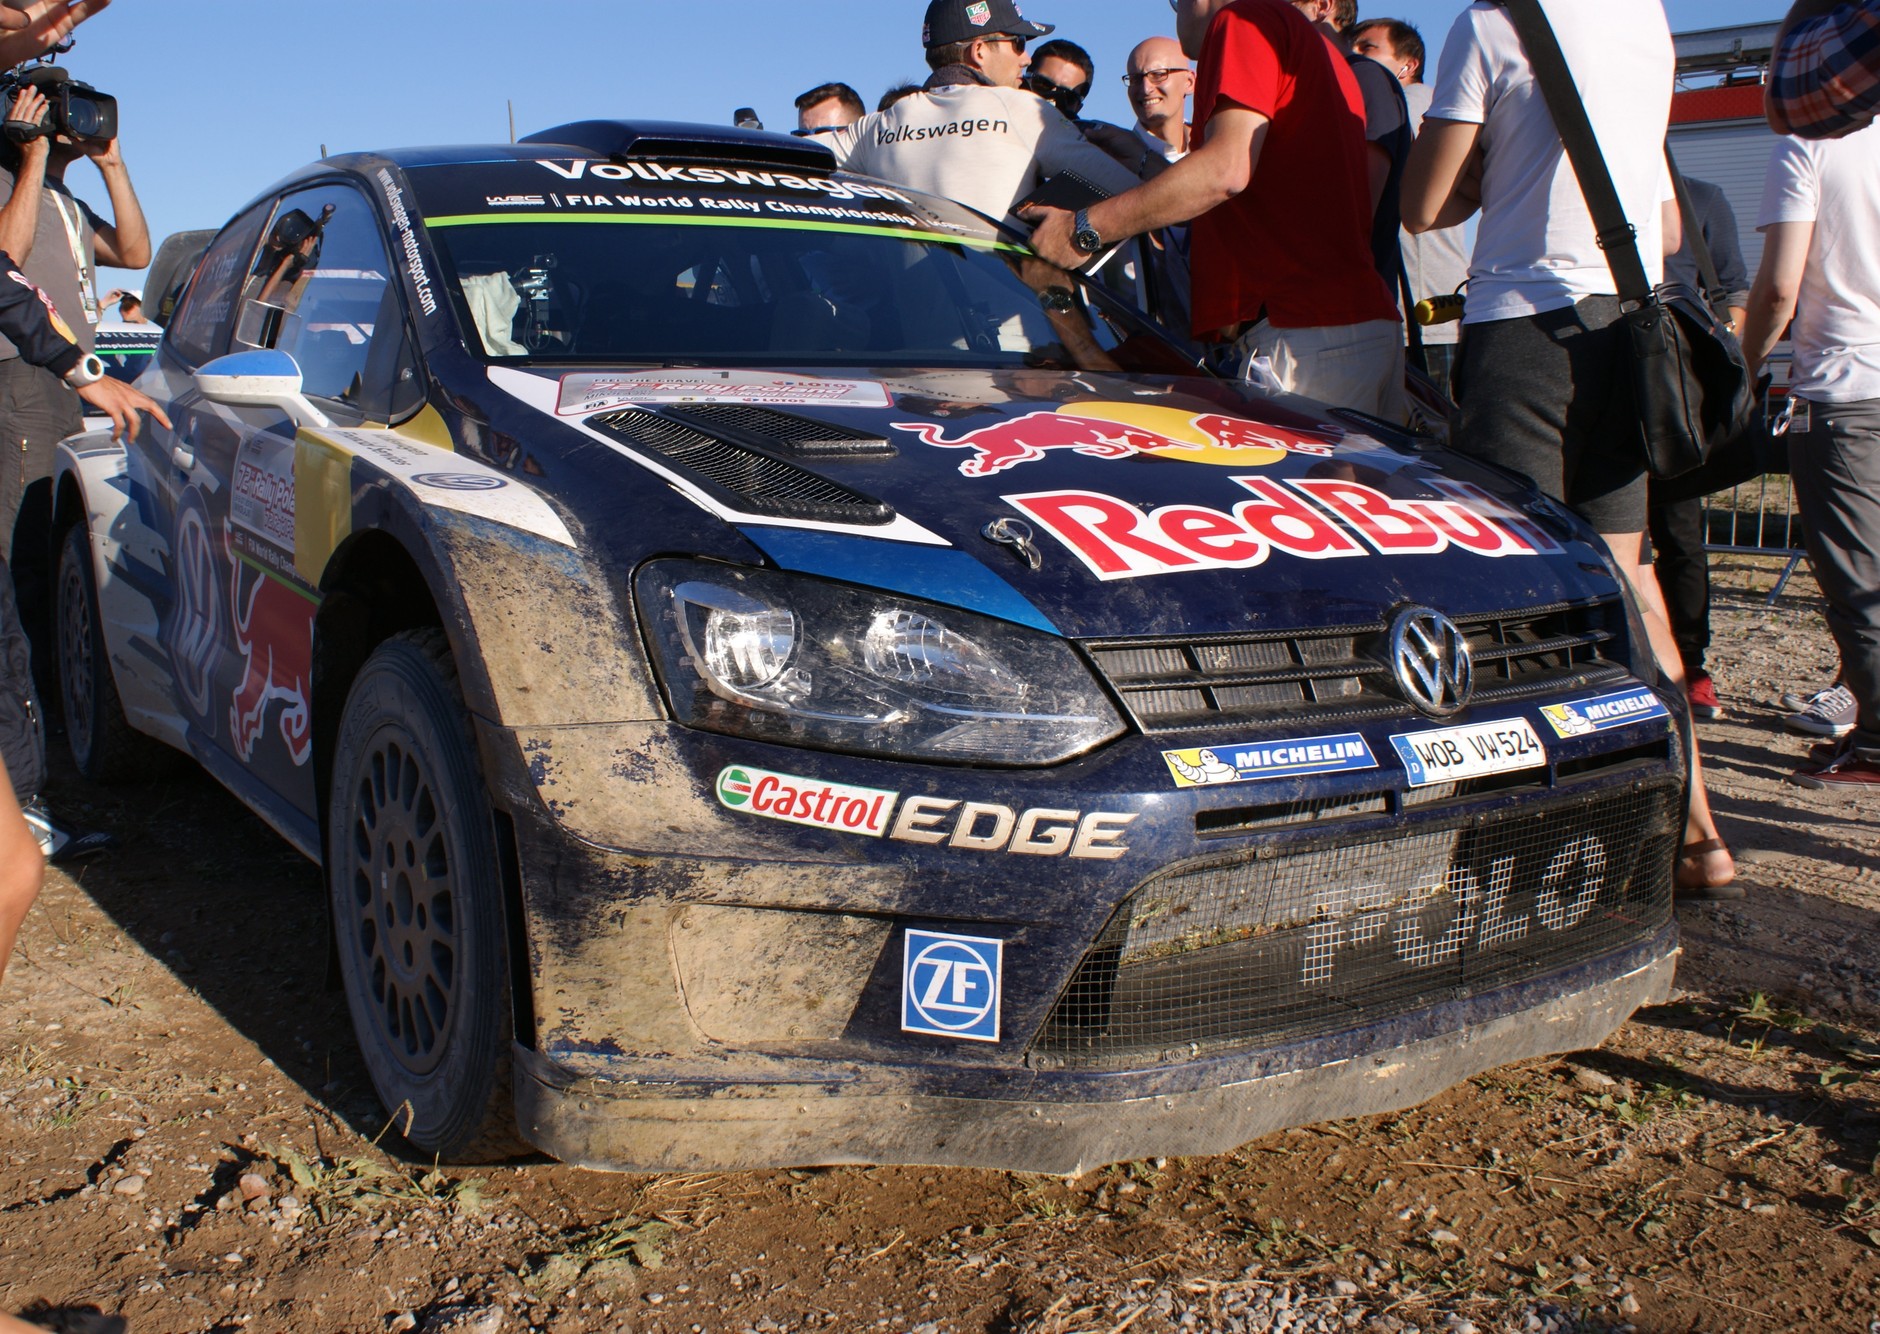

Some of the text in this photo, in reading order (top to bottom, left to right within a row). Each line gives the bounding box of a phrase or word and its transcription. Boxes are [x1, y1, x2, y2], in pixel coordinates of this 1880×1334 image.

[877, 118, 1008, 146] Volkswagen
[535, 160, 912, 204] Volkswagen
[565, 195, 613, 206] FIA
[615, 195, 694, 208] World
[699, 197, 760, 213] Rally
[766, 200, 917, 227] Championship
[377, 167, 437, 316] www.volkswagen-motorsport.com
[95, 342, 158, 350] ampionship
[652, 383, 736, 394] Rally
[736, 384, 850, 395] Poland
[798, 381, 857, 389] LOTOS
[584, 400, 608, 410] FIA
[252, 471, 277, 509] Rally
[274, 477, 295, 517] Pola
[1584, 693, 1659, 721] MICHELIN
[1235, 741, 1365, 769] MICHELIN
[1412, 763, 1420, 774] D
[1414, 740, 1463, 769] WOB
[751, 775, 1139, 859] Castrol EDGE
[1301, 833, 1607, 986] POLO
[917, 956, 987, 1015] ZF
